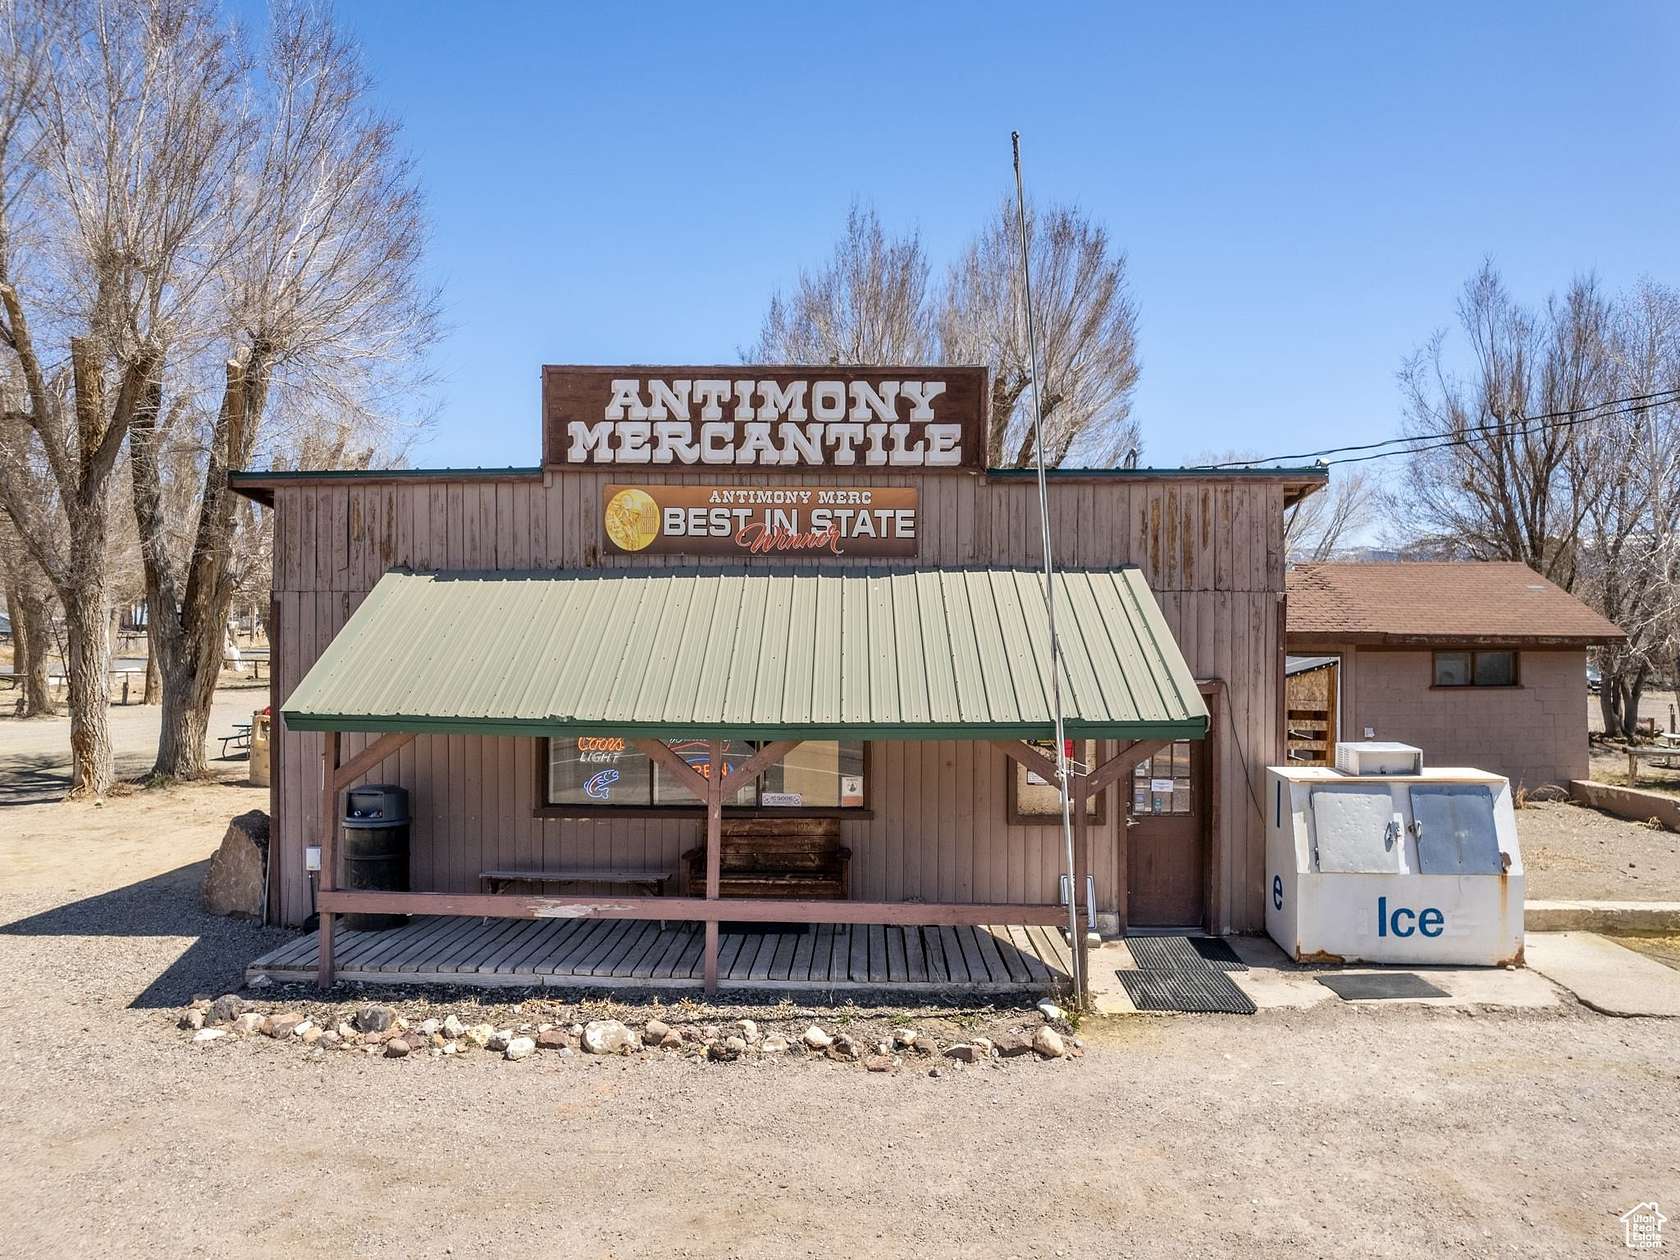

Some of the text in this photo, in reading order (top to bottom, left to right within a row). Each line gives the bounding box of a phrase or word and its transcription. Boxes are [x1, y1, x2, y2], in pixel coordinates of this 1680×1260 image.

[604, 379, 947, 422] ANTIMONY
[567, 421, 962, 466] MERCANTILE
[709, 490, 872, 505] ANTIMONY MERC
[663, 507, 916, 539] BEST IN STATE
[735, 522, 845, 554] Winner
[578, 736, 625, 751] Coors
[580, 752, 621, 763] LIGHT
[1378, 896, 1444, 938] Ice
